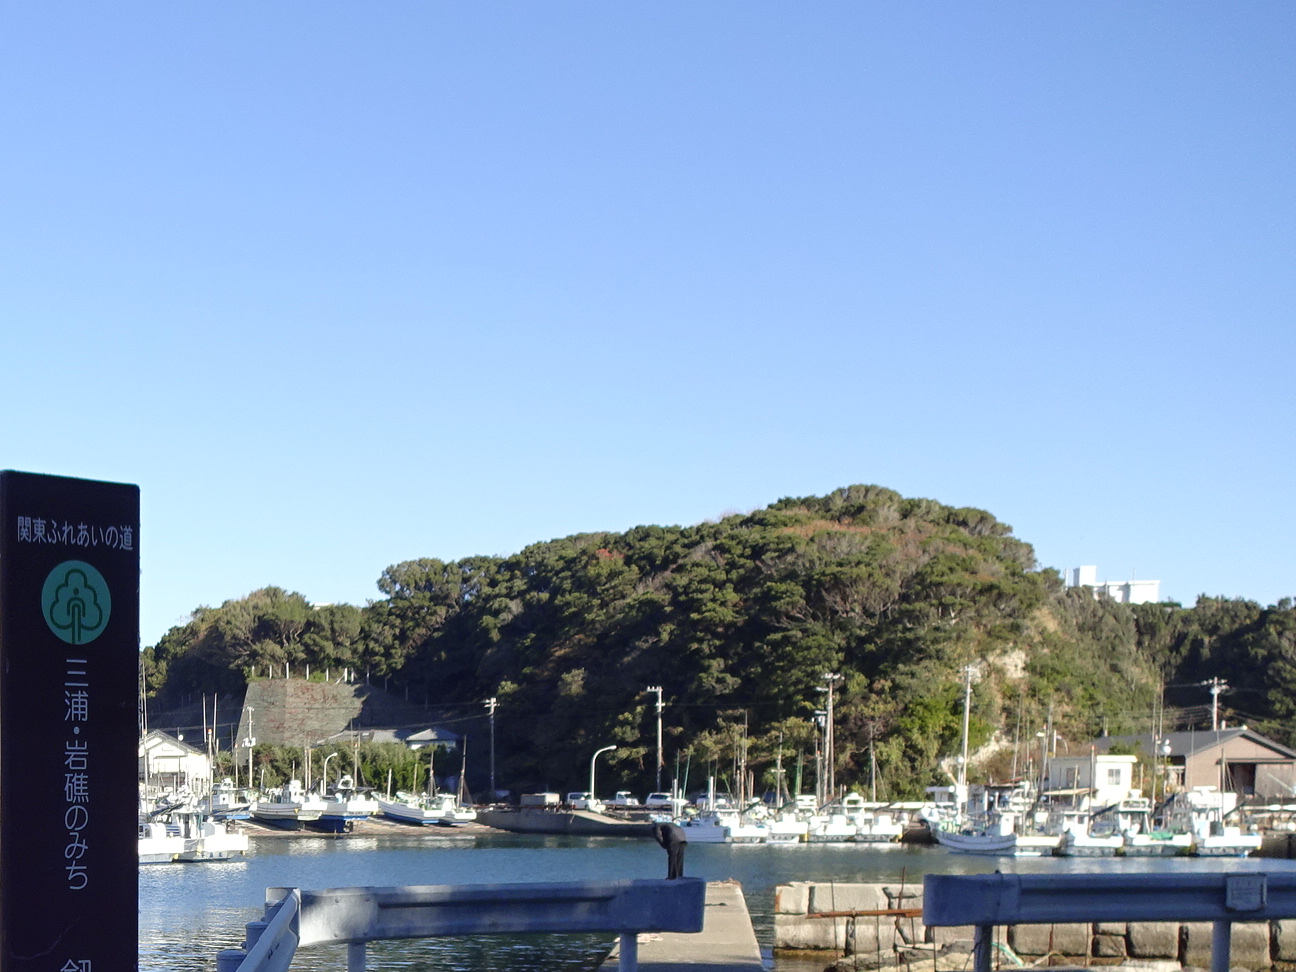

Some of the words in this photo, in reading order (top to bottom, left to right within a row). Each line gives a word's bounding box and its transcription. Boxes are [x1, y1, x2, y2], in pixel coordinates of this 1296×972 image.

[17, 516, 134, 550] 関東ふれあいの道
[64, 658, 91, 890] 三浦・岩礁のみち
